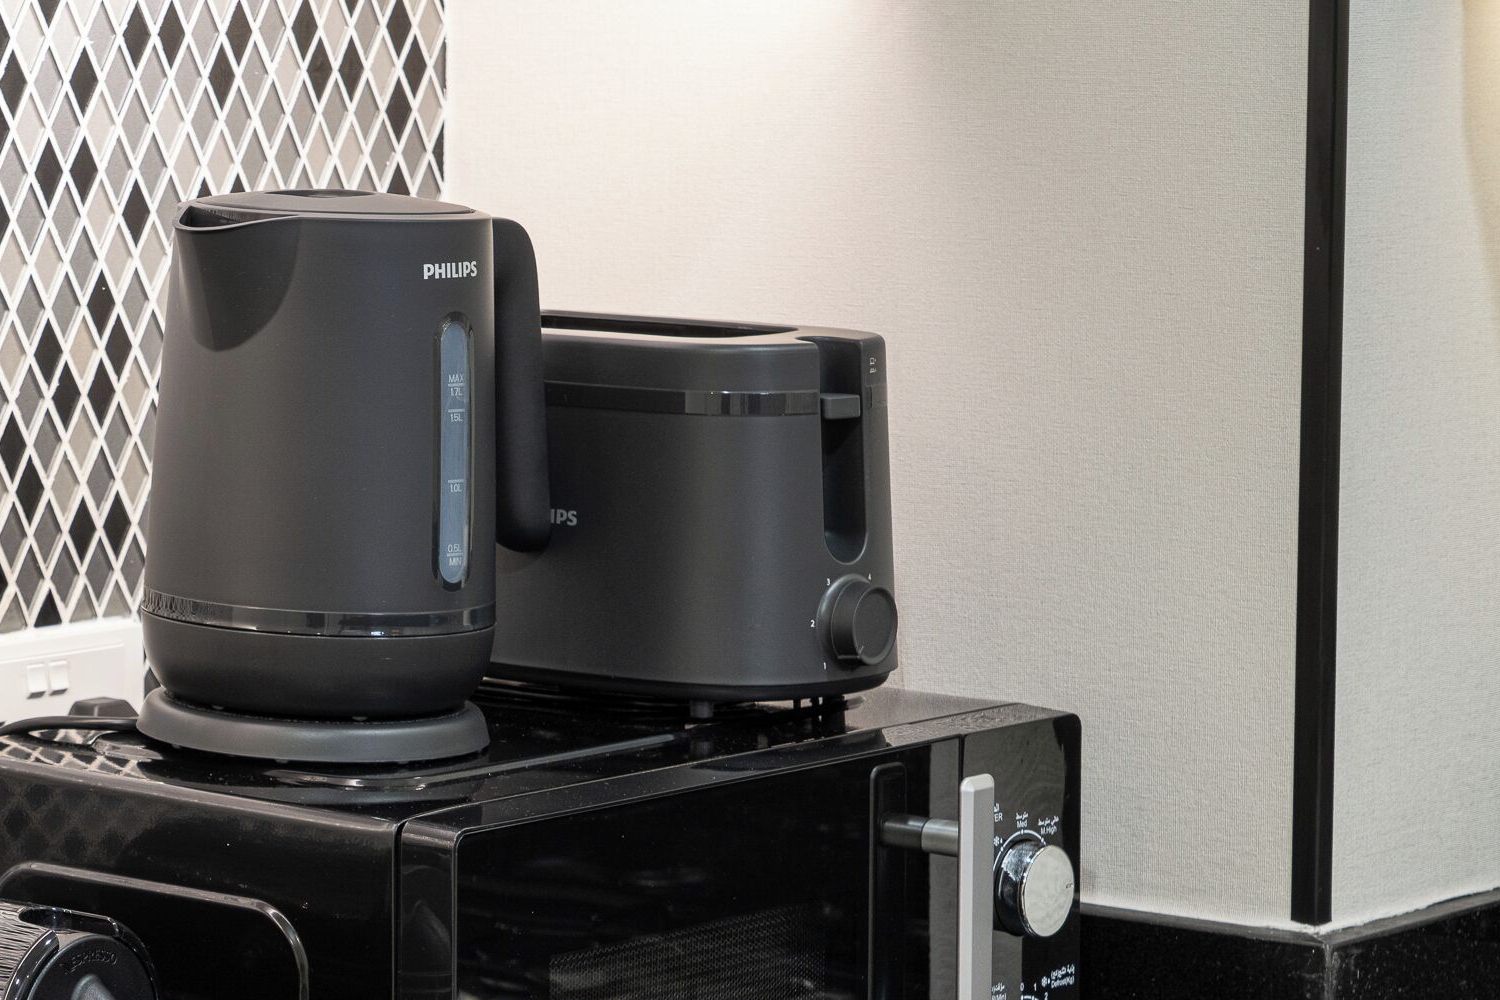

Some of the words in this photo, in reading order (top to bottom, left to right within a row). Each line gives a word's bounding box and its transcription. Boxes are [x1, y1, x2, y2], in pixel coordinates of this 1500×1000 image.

[423, 261, 478, 280] PHILIPS
[448, 374, 464, 383] MAX
[448, 557, 462, 566] MIN
[826, 578, 831, 586] 3
[810, 619, 816, 628] 2
[59, 949, 118, 976] NESPRESSO
[1020, 982, 1025, 992] 0
[1033, 982, 1038, 992] 1
[1044, 991, 1049, 1000] 2
